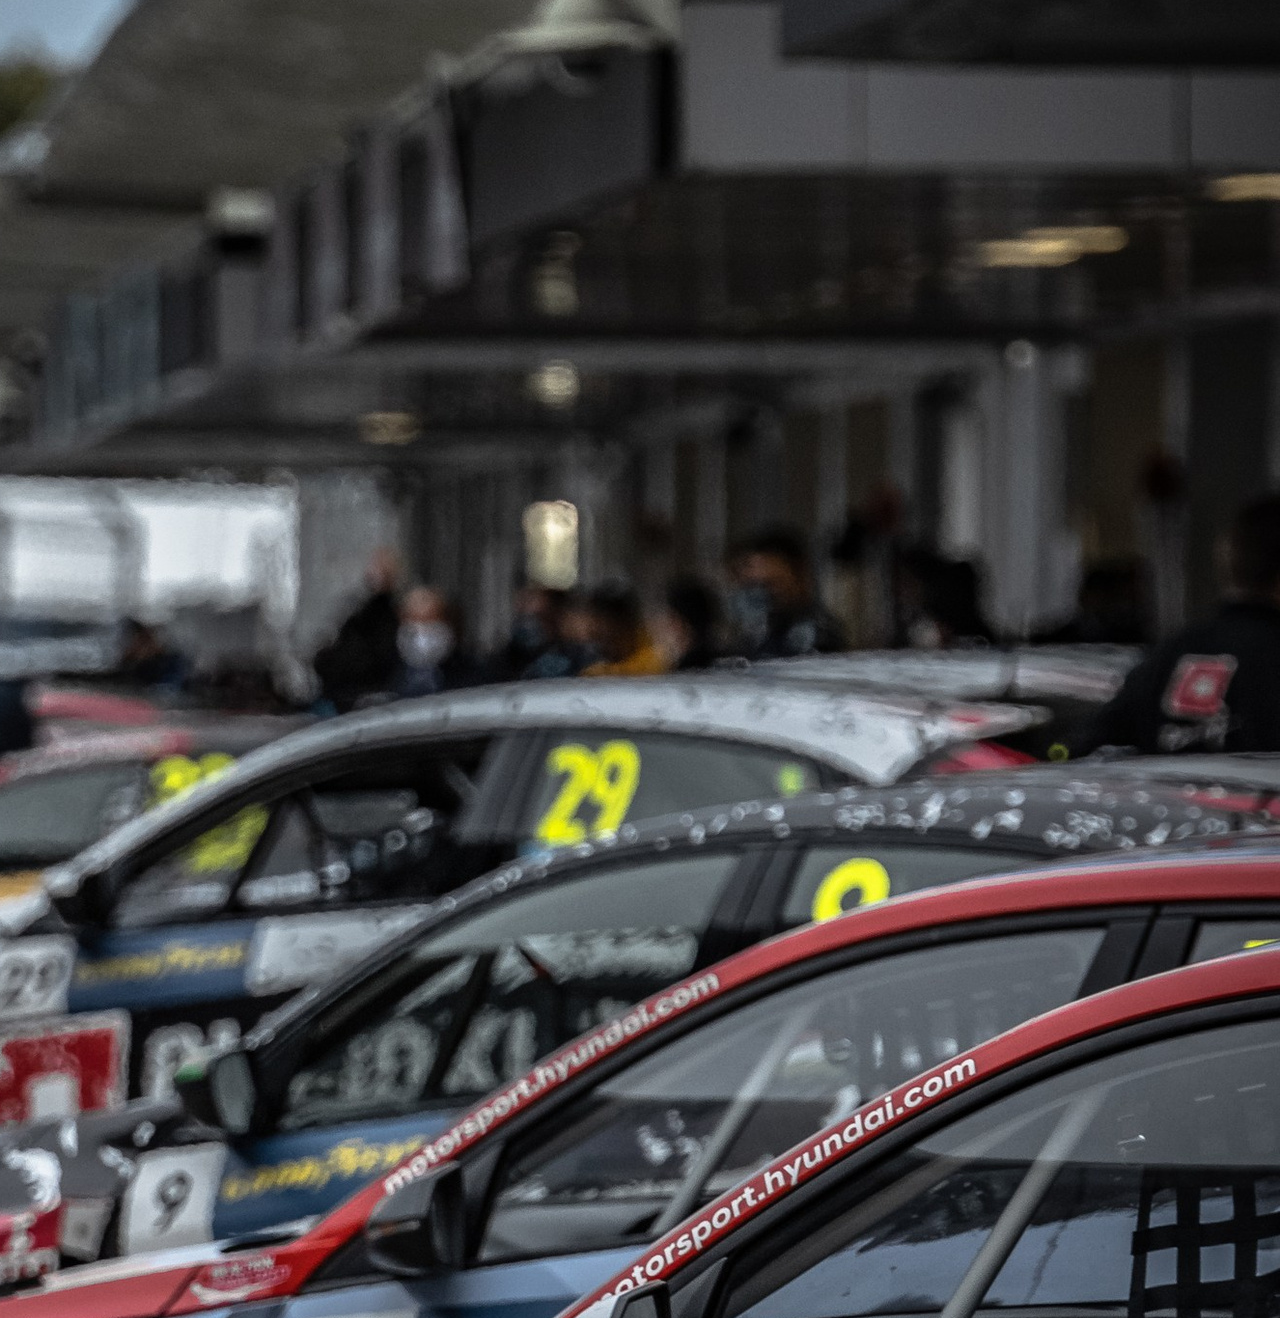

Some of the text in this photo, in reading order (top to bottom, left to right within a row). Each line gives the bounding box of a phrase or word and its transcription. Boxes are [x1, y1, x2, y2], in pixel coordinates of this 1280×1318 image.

[536, 739, 642, 846] 29
[384, 972, 720, 1196] motorsport.hyundai.com
[152, 1170, 194, 1228] 9
[601, 1057, 977, 1299] otorsport.hyundai.com
